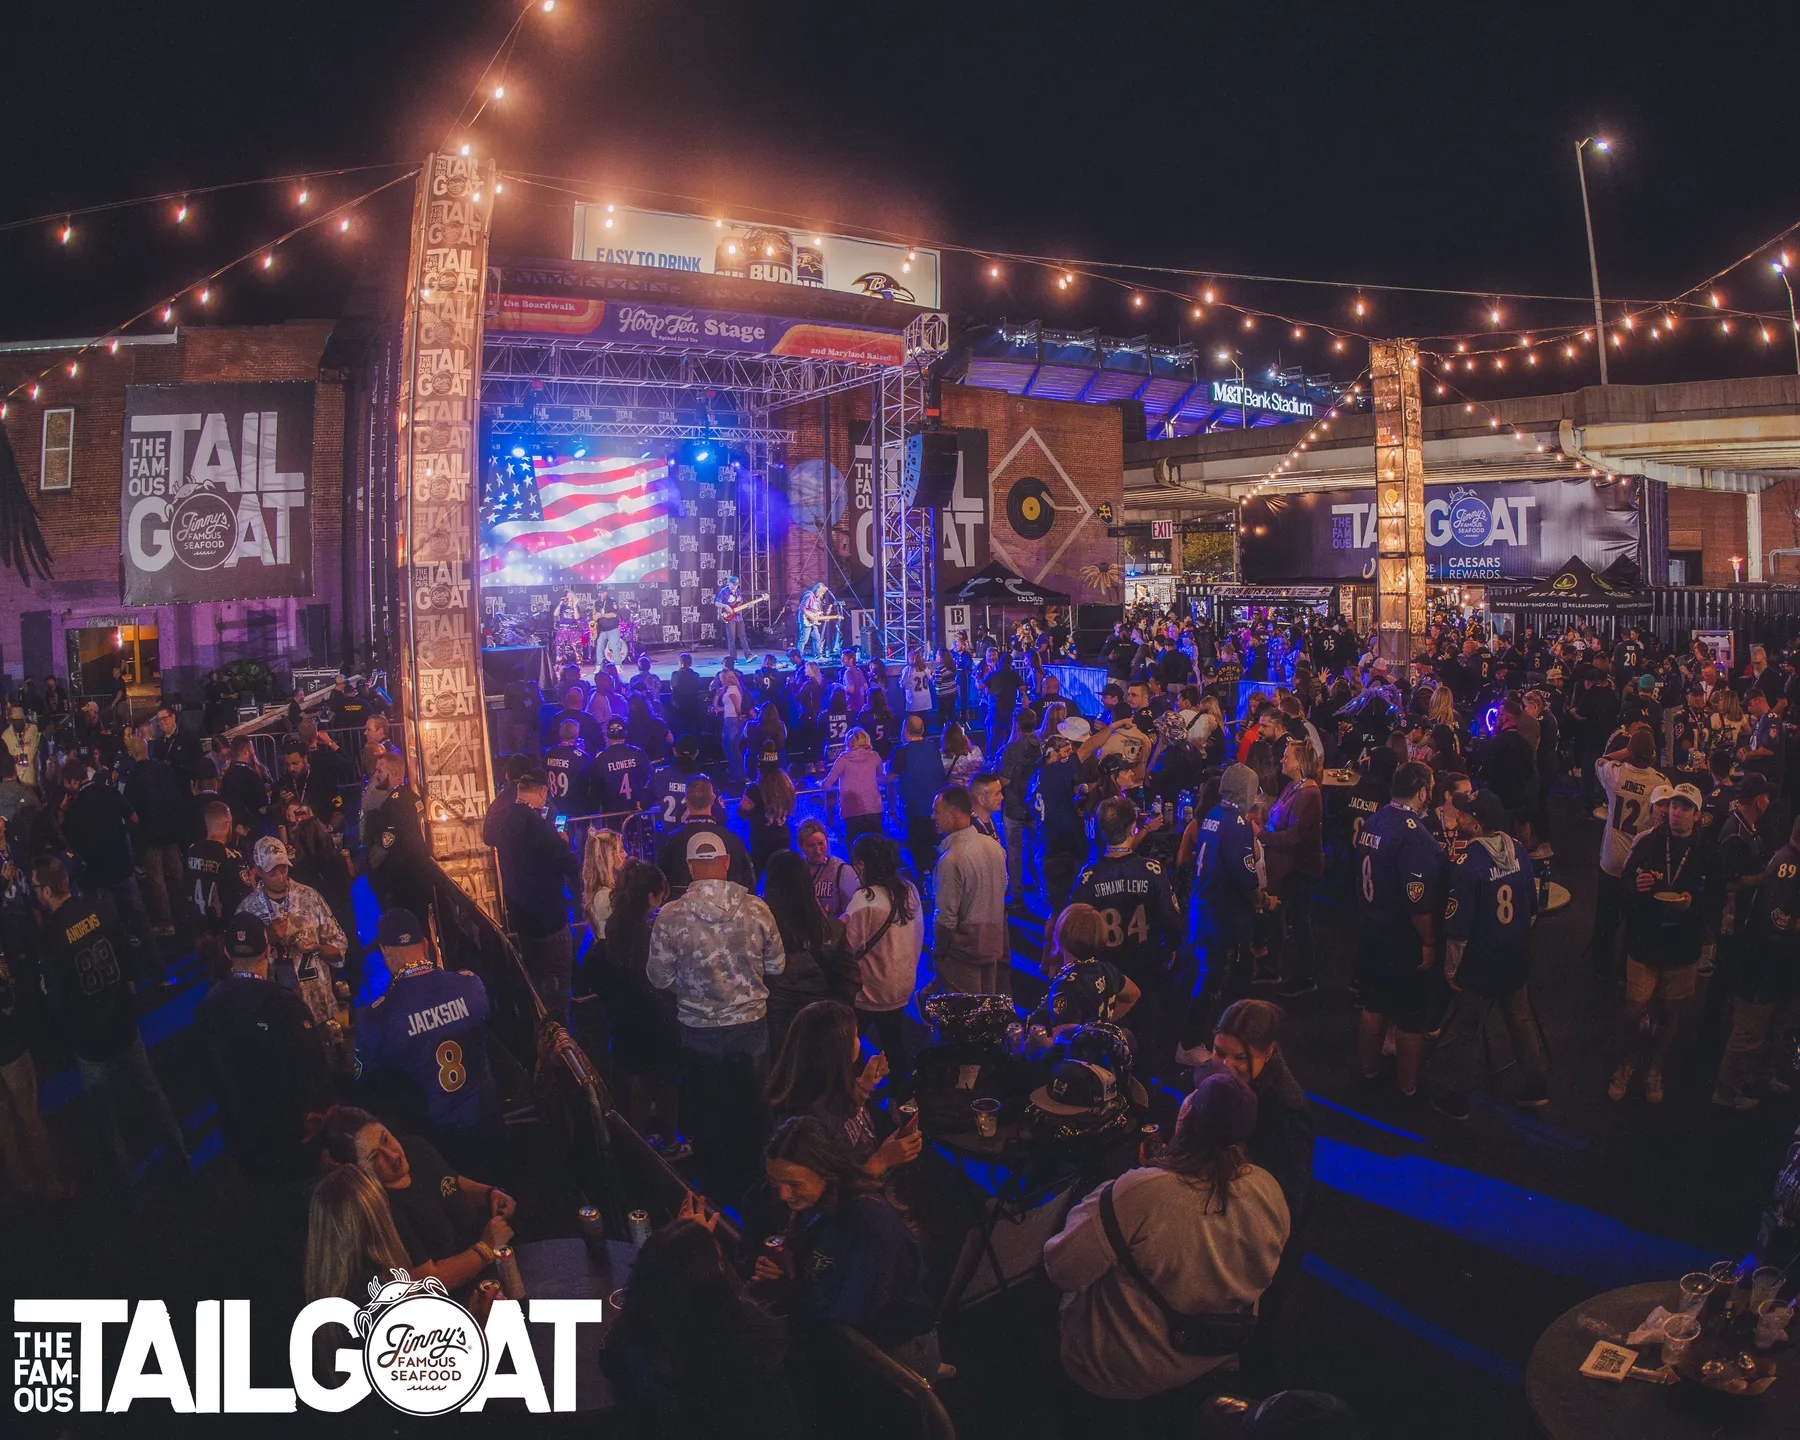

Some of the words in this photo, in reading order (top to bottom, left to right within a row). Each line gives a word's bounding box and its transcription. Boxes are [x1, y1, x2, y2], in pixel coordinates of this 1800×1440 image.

[427, 248, 478, 274] TAIL
[596, 247, 634, 265] EASY
[636, 251, 655, 267] TO
[657, 253, 702, 272] DRINK
[522, 300, 576, 311] Boardwalk
[618, 307, 665, 338] Hoop
[665, 314, 699, 335] Tea
[704, 319, 765, 343] Stage
[420, 349, 471, 374] TAIL
[810, 347, 826, 355] and
[828, 348, 865, 360] Maryland
[867, 352, 892, 362] Raised
[1213, 382, 1244, 404] M&T
[1244, 388, 1271, 409] Bank
[1272, 393, 1312, 416] Stadium
[130, 438, 166, 457] THE
[130, 411, 305, 495] TAIL
[415, 453, 470, 479] TAIL
[855, 463, 872, 479] TH
[128, 478, 166, 496] OUS
[855, 479, 872, 494] FA
[1152, 521, 1172, 538] EXIT
[1332, 517, 1351, 528] THE
[184, 540, 225, 550] SEAFOOD
[1332, 538, 1352, 549] OUS
[1449, 557, 1500, 568] CAESARS
[415, 560, 471, 586] TAIL
[1449, 569, 1500, 579] REWARDS
[1223, 586, 1243, 595] POOR
[1243, 586, 1263, 595] BOYS
[1263, 586, 1290, 595] SPORTS
[1323, 639, 1335, 651] 95
[1624, 652, 1637, 667] 20
[419, 667, 475, 693] TAIL
[763, 677, 771, 689] 9
[829, 722, 848, 738] 52
[875, 725, 884, 740] 5
[547, 757, 570, 769] ANDREWS
[608, 758, 637, 772] FLOWERS
[427, 773, 485, 799] TAIL
[548, 770, 569, 797] 89
[619, 773, 632, 800] 4
[669, 782, 687, 793] HENR
[1621, 779, 1646, 796] JONES
[1348, 796, 1379, 813] JACKSON
[1236, 816, 1246, 826] 4
[1406, 818, 1417, 829] 8
[1613, 795, 1641, 835] 12
[187, 856, 222, 875] HUMPHREY
[1456, 853, 1469, 865] 8
[1145, 861, 1162, 875] 8
[1778, 862, 1796, 878] 89
[1081, 871, 1093, 884] 4
[1362, 855, 1375, 902] 8
[1127, 879, 1149, 894] LEWIS
[1496, 884, 1514, 925] 8
[65, 913, 101, 944] ANDREWS
[1099, 903, 1149, 948] 84
[75, 938, 121, 996] 89
[407, 997, 470, 1036] JACKSON
[435, 1040, 467, 1092] 8
